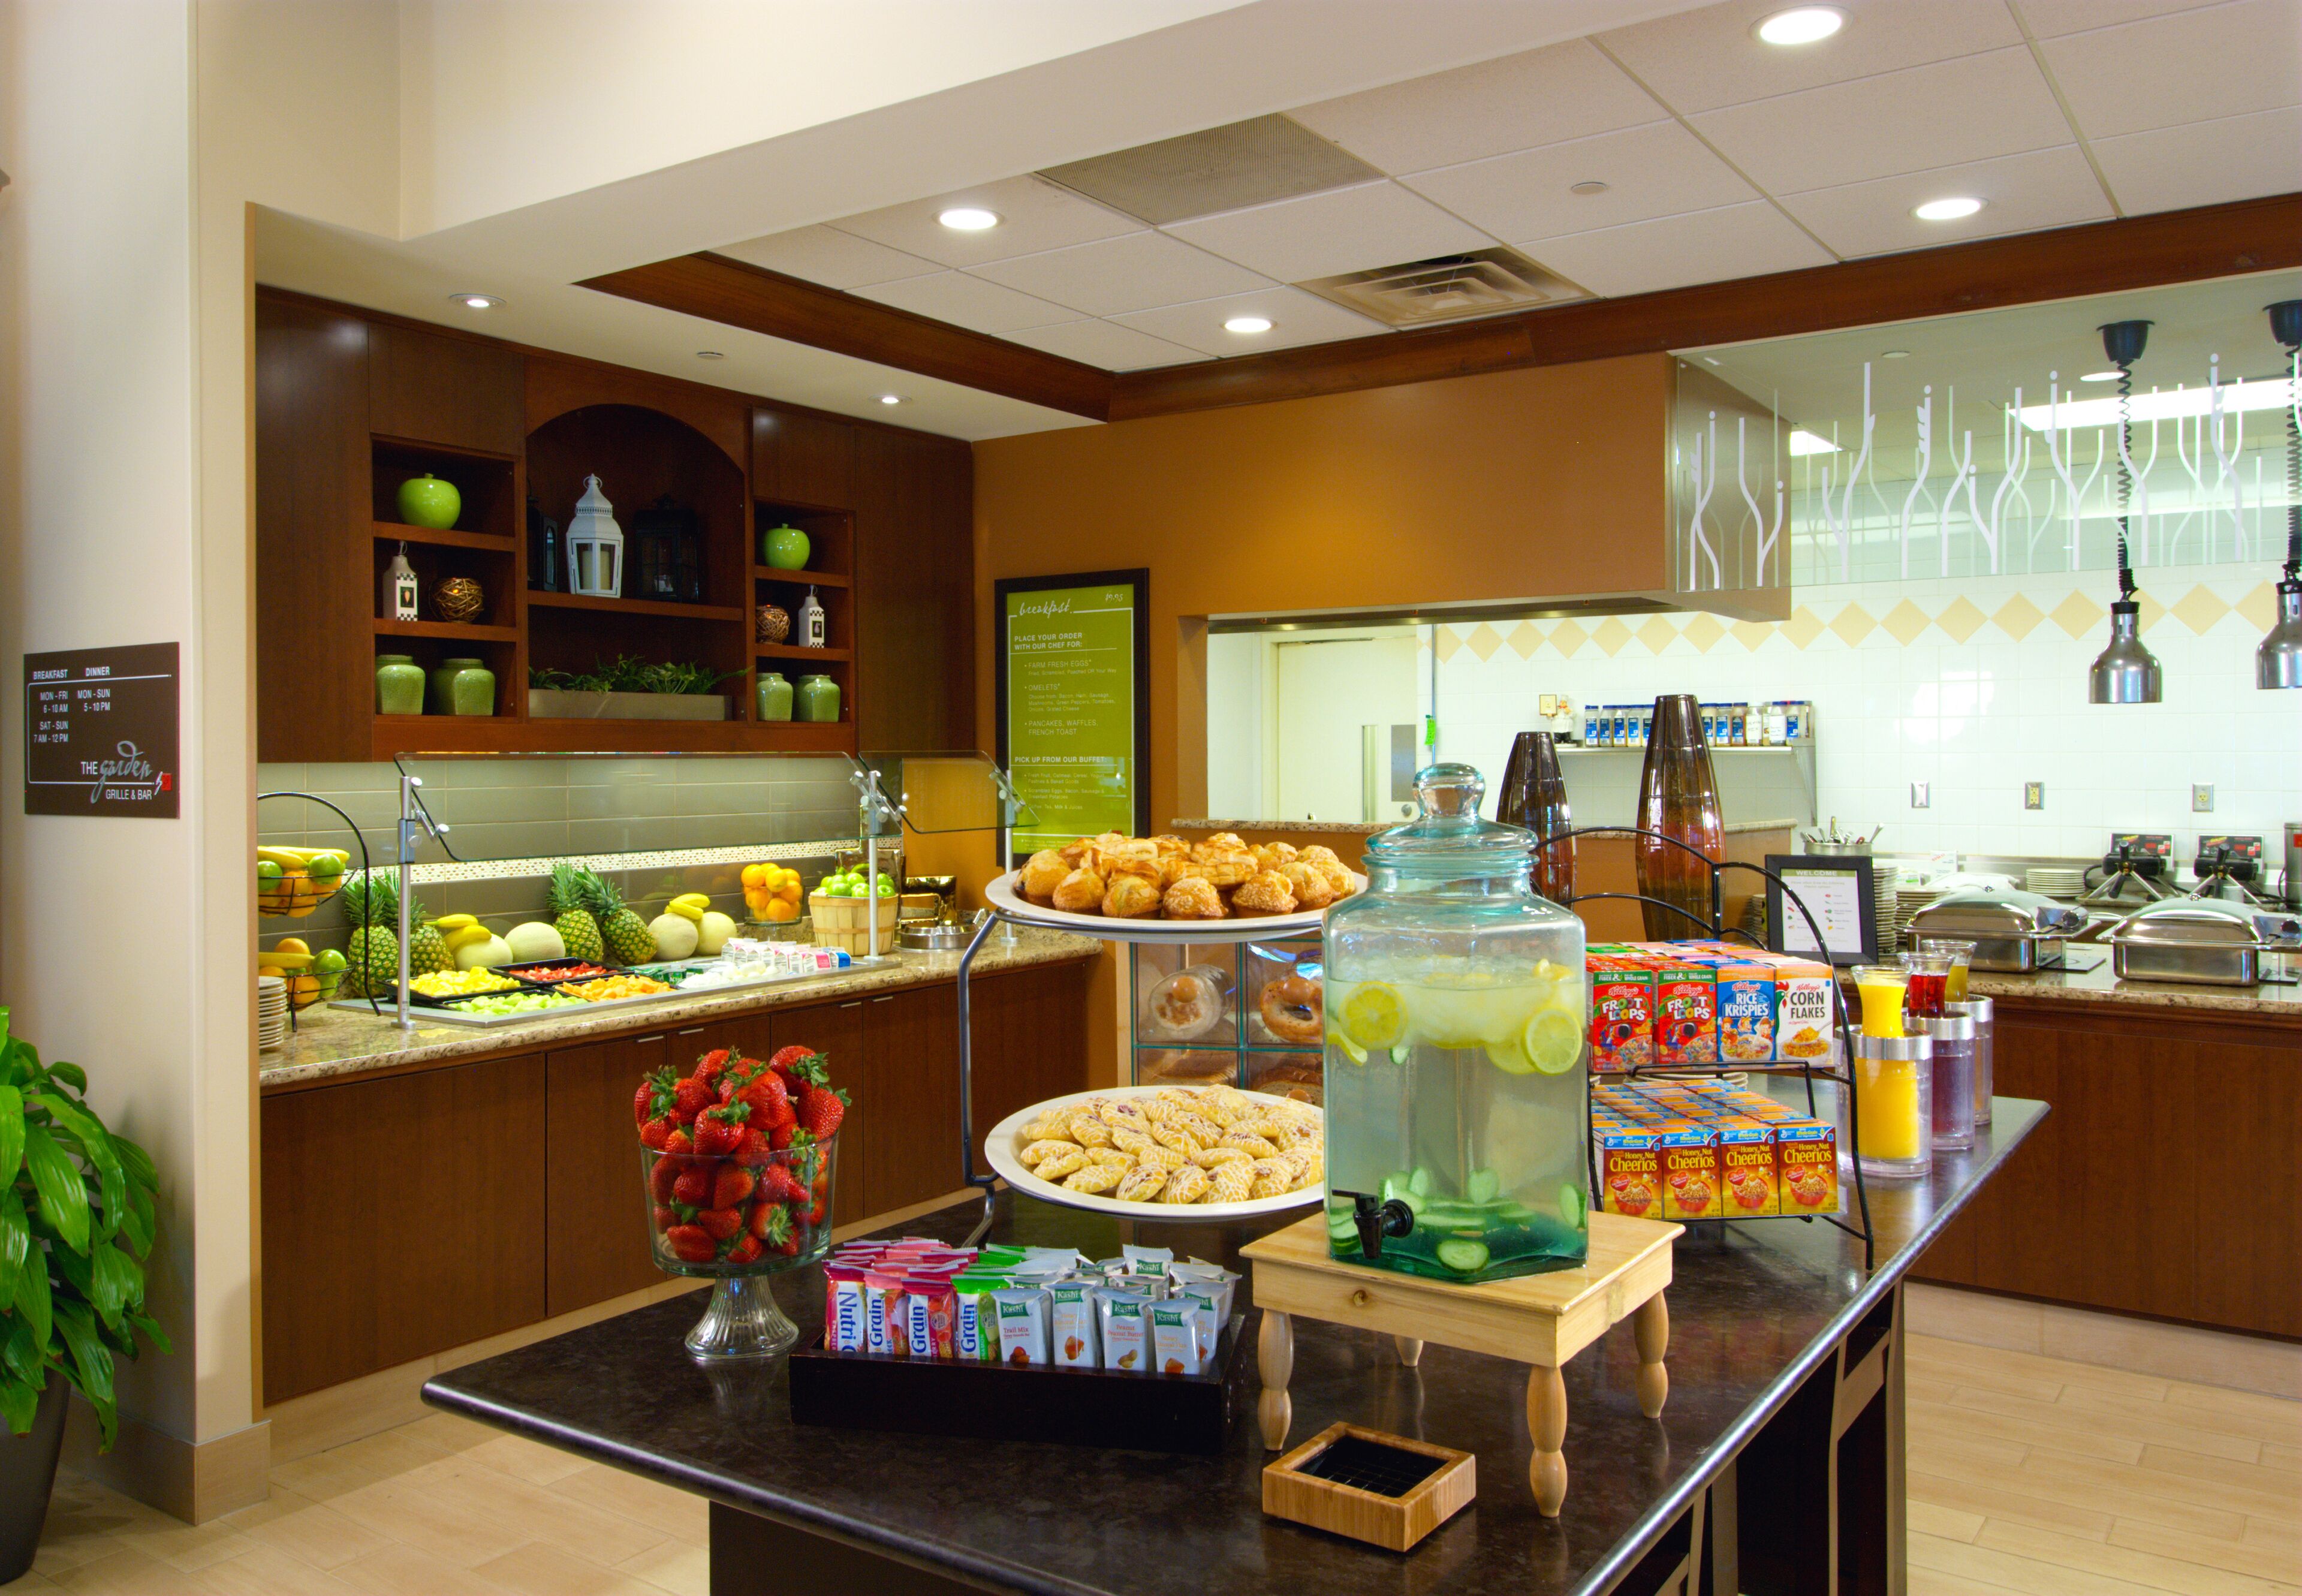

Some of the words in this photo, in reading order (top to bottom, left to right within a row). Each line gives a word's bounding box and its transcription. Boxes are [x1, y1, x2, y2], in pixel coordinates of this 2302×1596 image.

[1020, 598, 1071, 618] breakfast
[33, 669, 68, 680] BREAKFAST
[85, 666, 110, 677] DINNER
[40, 692, 54, 700] MON
[59, 691, 68, 699] FRI
[77, 690, 92, 699] MON
[97, 689, 110, 698] SUN
[43, 705, 47, 713] 6
[52, 704, 58, 713] 10
[60, 704, 68, 712] AM
[84, 703, 88, 712] 5
[93, 703, 100, 711] 10
[101, 702, 110, 711] PM
[40, 721, 51, 730] SAT
[56, 721, 68, 730] SUN
[34, 734, 37, 743] 7
[38, 734, 47, 742] AM
[52, 734, 58, 742] 12
[60, 733, 68, 742] PM
[80, 761, 98, 775] THE
[91, 740, 153, 804] garden
[106, 789, 129, 800] GRILLE
[131, 790, 136, 800] &
[138, 790, 152, 800] BAR
[1608, 986, 1639, 998] Kellogg's
[1673, 984, 1703, 996] Kellogg's
[1732, 981, 1761, 992] Kellogg's
[1796, 983, 1820, 992] Kellogg's
[1667, 996, 1707, 1013] FROOT
[1736, 993, 1758, 1004] RICE
[1790, 992, 1824, 1005] CORN
[1602, 998, 1643, 1014] FROOT
[1725, 1004, 1768, 1016] KRISPIES
[1608, 1008, 1646, 1021] LOOPS
[1674, 1007, 1711, 1020] LOOPS
[1791, 1007, 1825, 1019] FLAKES
[1625, 1152, 1643, 1161] Honey
[1682, 1149, 1700, 1157] Honey
[1726, 1151, 1773, 1166] Cheerios
[1784, 1149, 1832, 1164] Cheerios
[1610, 1157, 1658, 1172] Cheerios
[1668, 1155, 1715, 1169] Cheerios
[1057, 1291, 1078, 1299] Kashi
[1003, 1305, 1023, 1314] Kashi
[1114, 1305, 1135, 1313] Kashi
[838, 1292, 857, 1339] Nutri
[1156, 1313, 1178, 1323] Kashi
[869, 1299, 882, 1347] Grain
[960, 1305, 976, 1353] Grain
[911, 1306, 927, 1353] Grain
